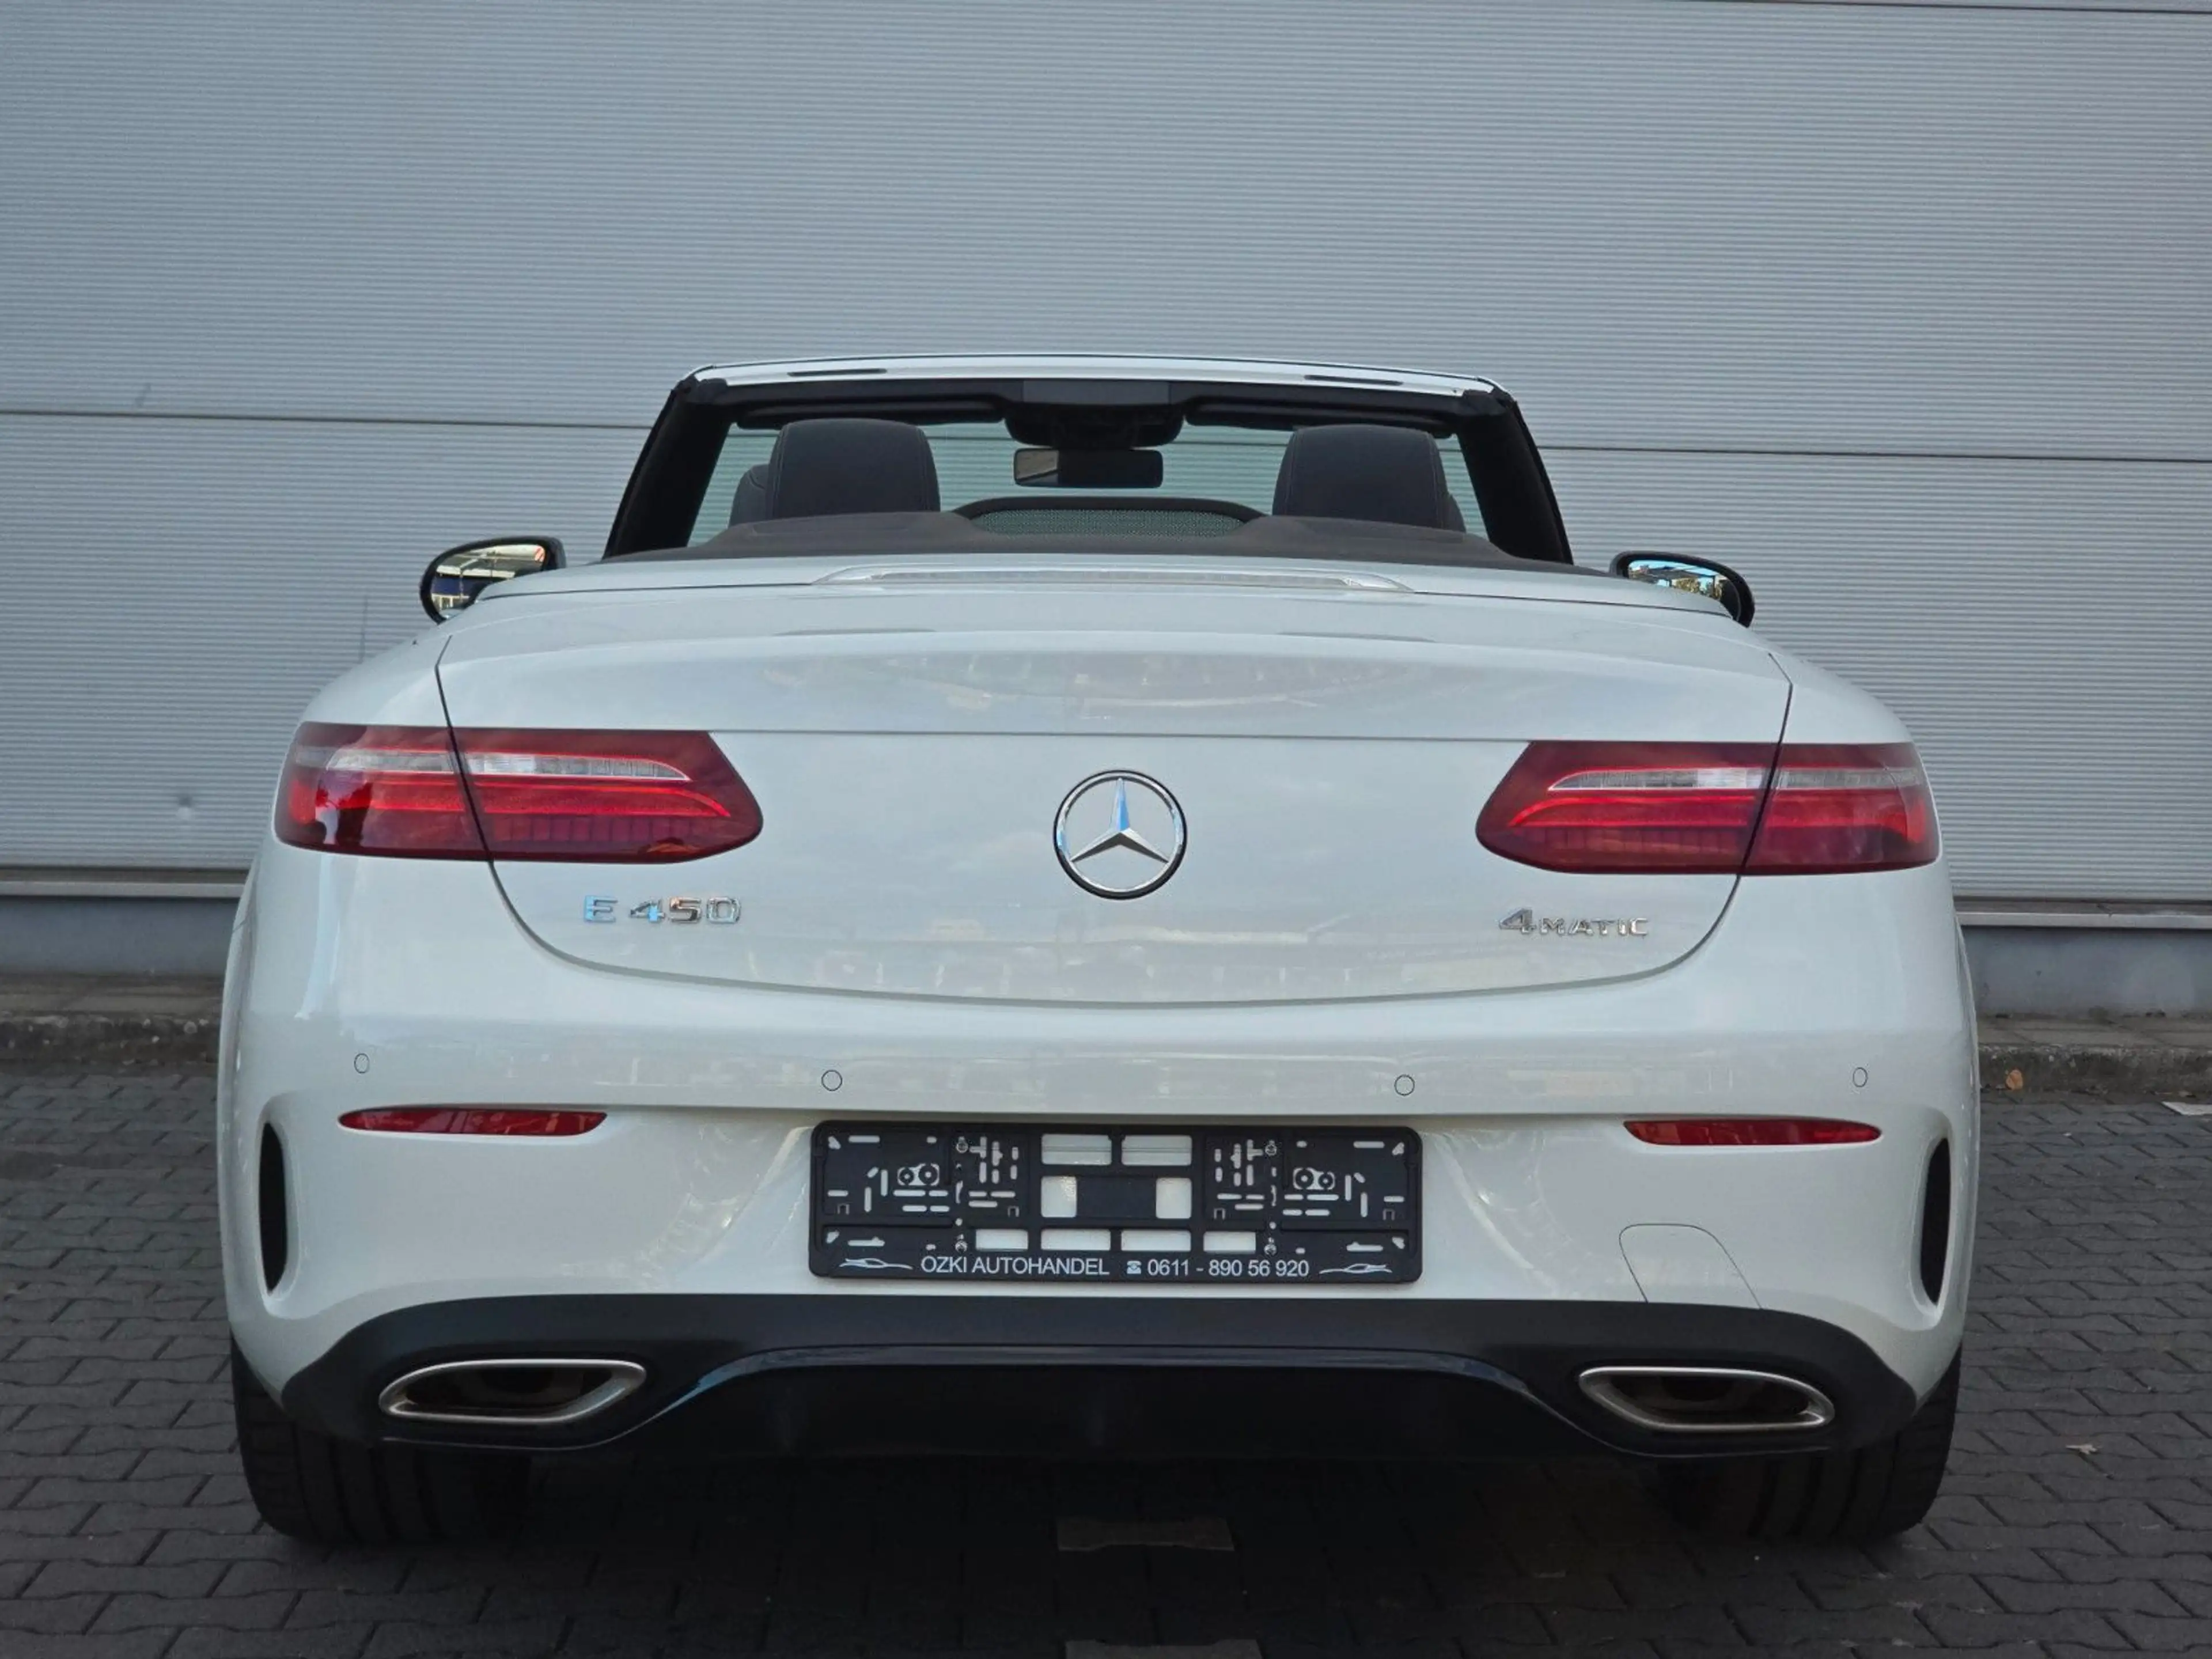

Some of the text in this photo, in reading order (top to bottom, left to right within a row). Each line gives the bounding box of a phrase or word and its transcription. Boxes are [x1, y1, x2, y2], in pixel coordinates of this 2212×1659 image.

[584, 895, 742, 923] E 450
[1499, 907, 1649, 936] 4MATIC
[971, 1256, 1111, 1275] AUTOHANDEL
[1147, 1259, 1190, 1276] 0611
[1209, 1259, 1243, 1277] 890
[1248, 1259, 1270, 1277] 56
[1275, 1259, 1309, 1277] 920
